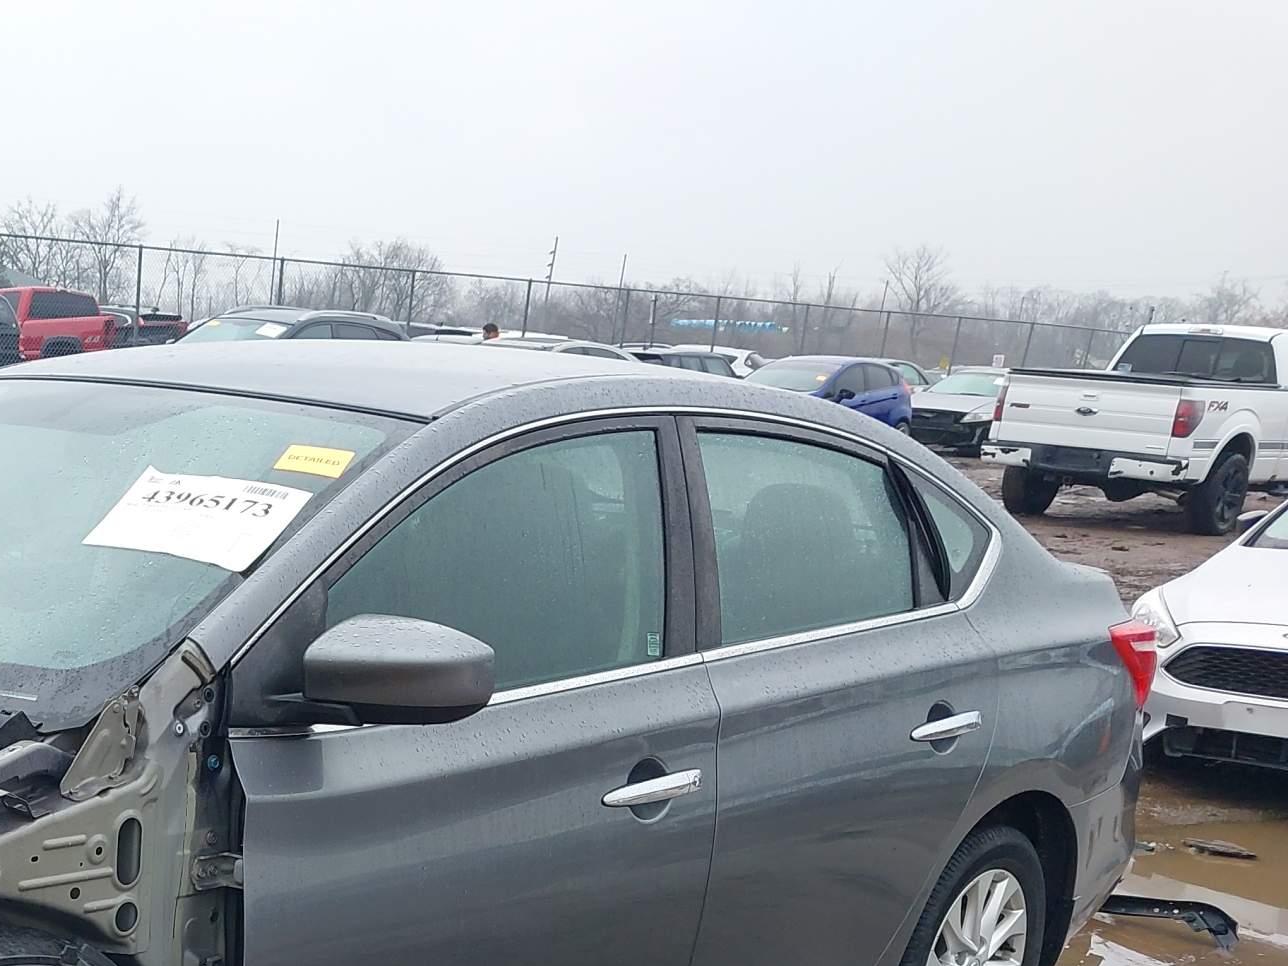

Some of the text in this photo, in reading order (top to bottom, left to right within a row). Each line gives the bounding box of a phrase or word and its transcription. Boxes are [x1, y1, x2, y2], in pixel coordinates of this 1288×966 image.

[1207, 400, 1229, 412] FX4
[286, 454, 341, 466] DETAILED
[141, 490, 273, 518] 43965173
